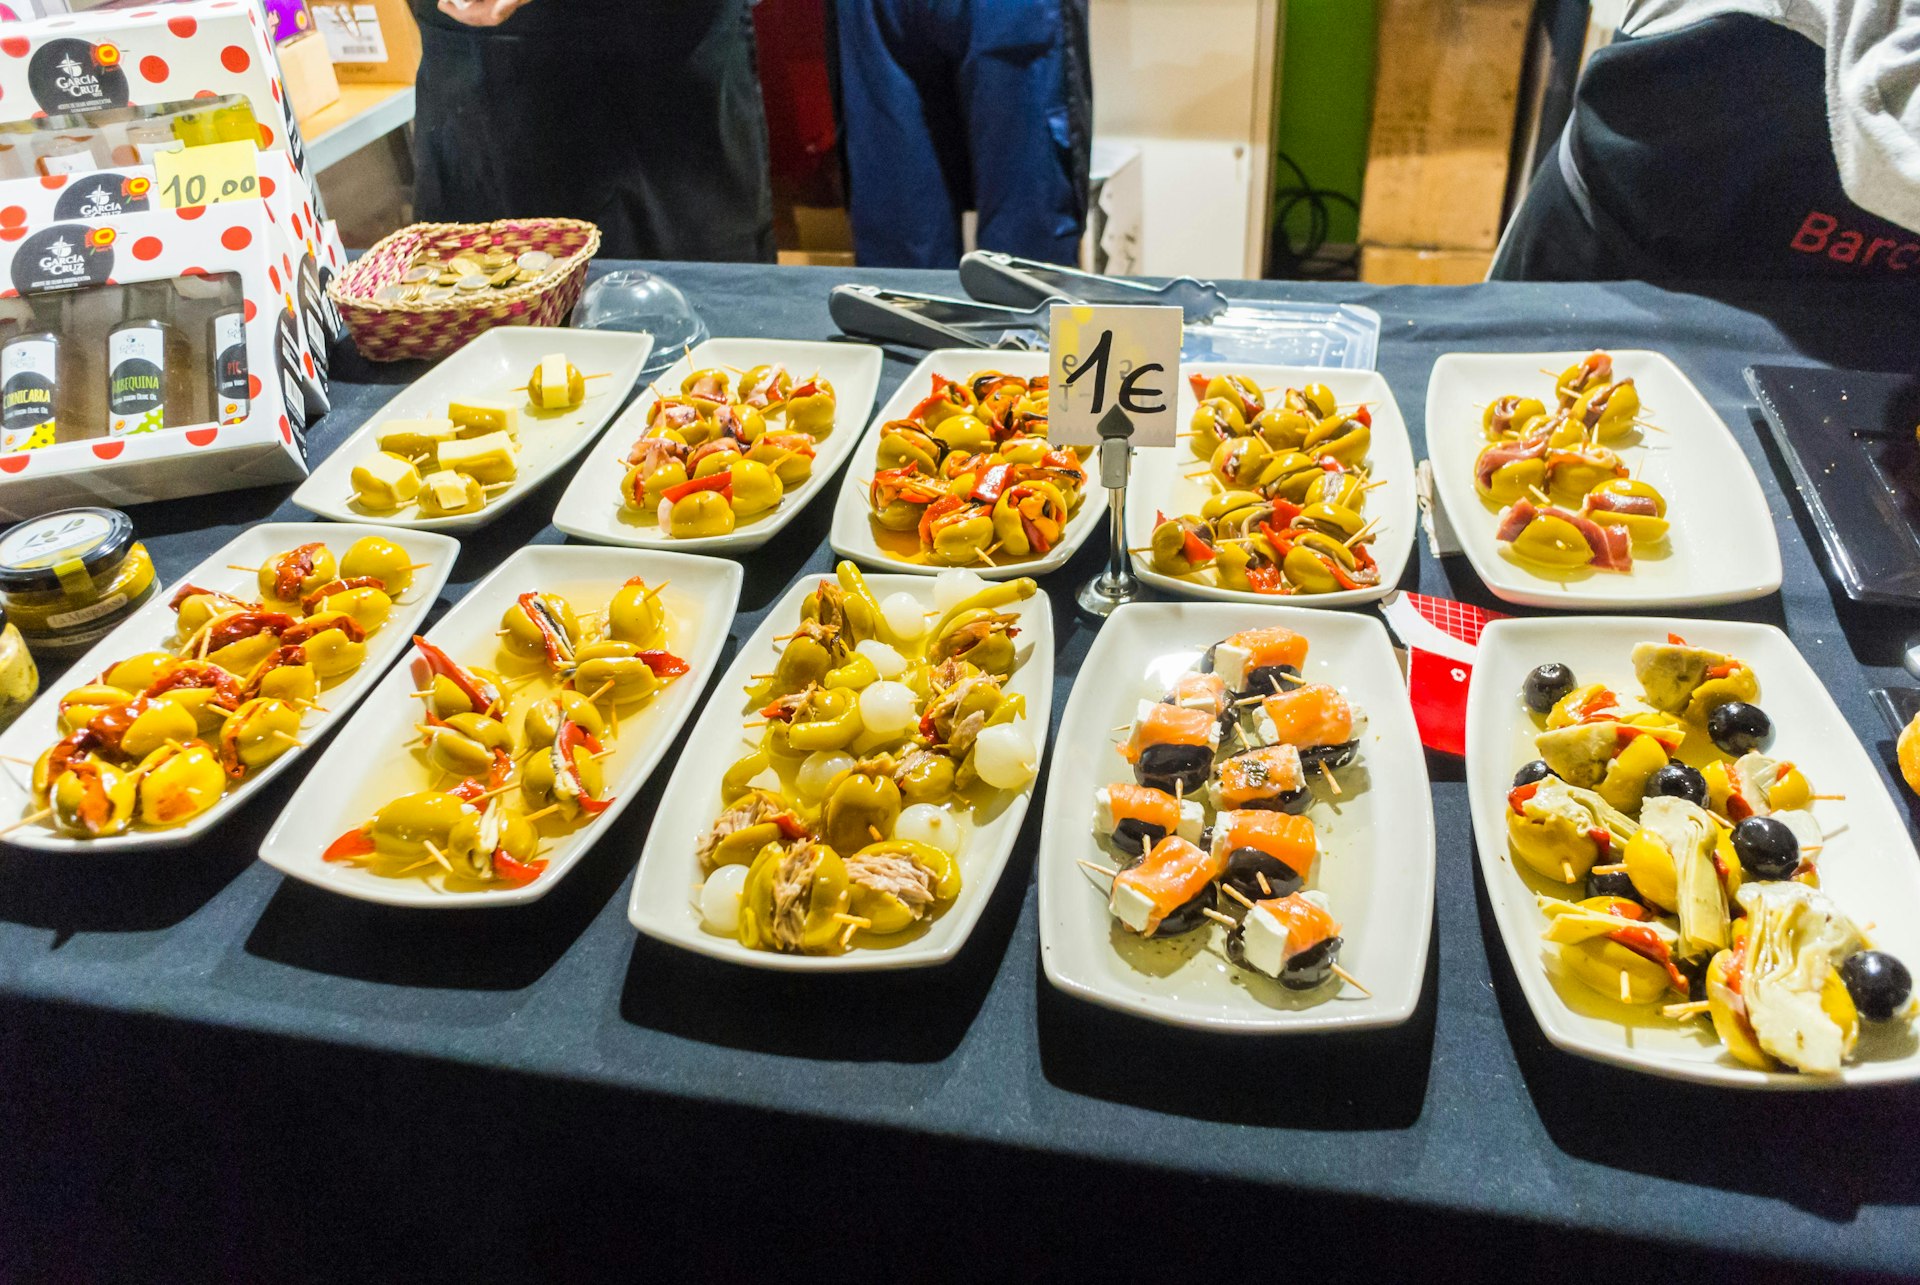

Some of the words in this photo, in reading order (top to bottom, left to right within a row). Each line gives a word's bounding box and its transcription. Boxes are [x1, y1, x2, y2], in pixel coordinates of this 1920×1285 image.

[70, 84, 100, 97] CRUZ
[1790, 210, 1920, 271] Barc
[50, 262, 85, 275] CRUZ
[1066, 329, 1167, 414] 1€
